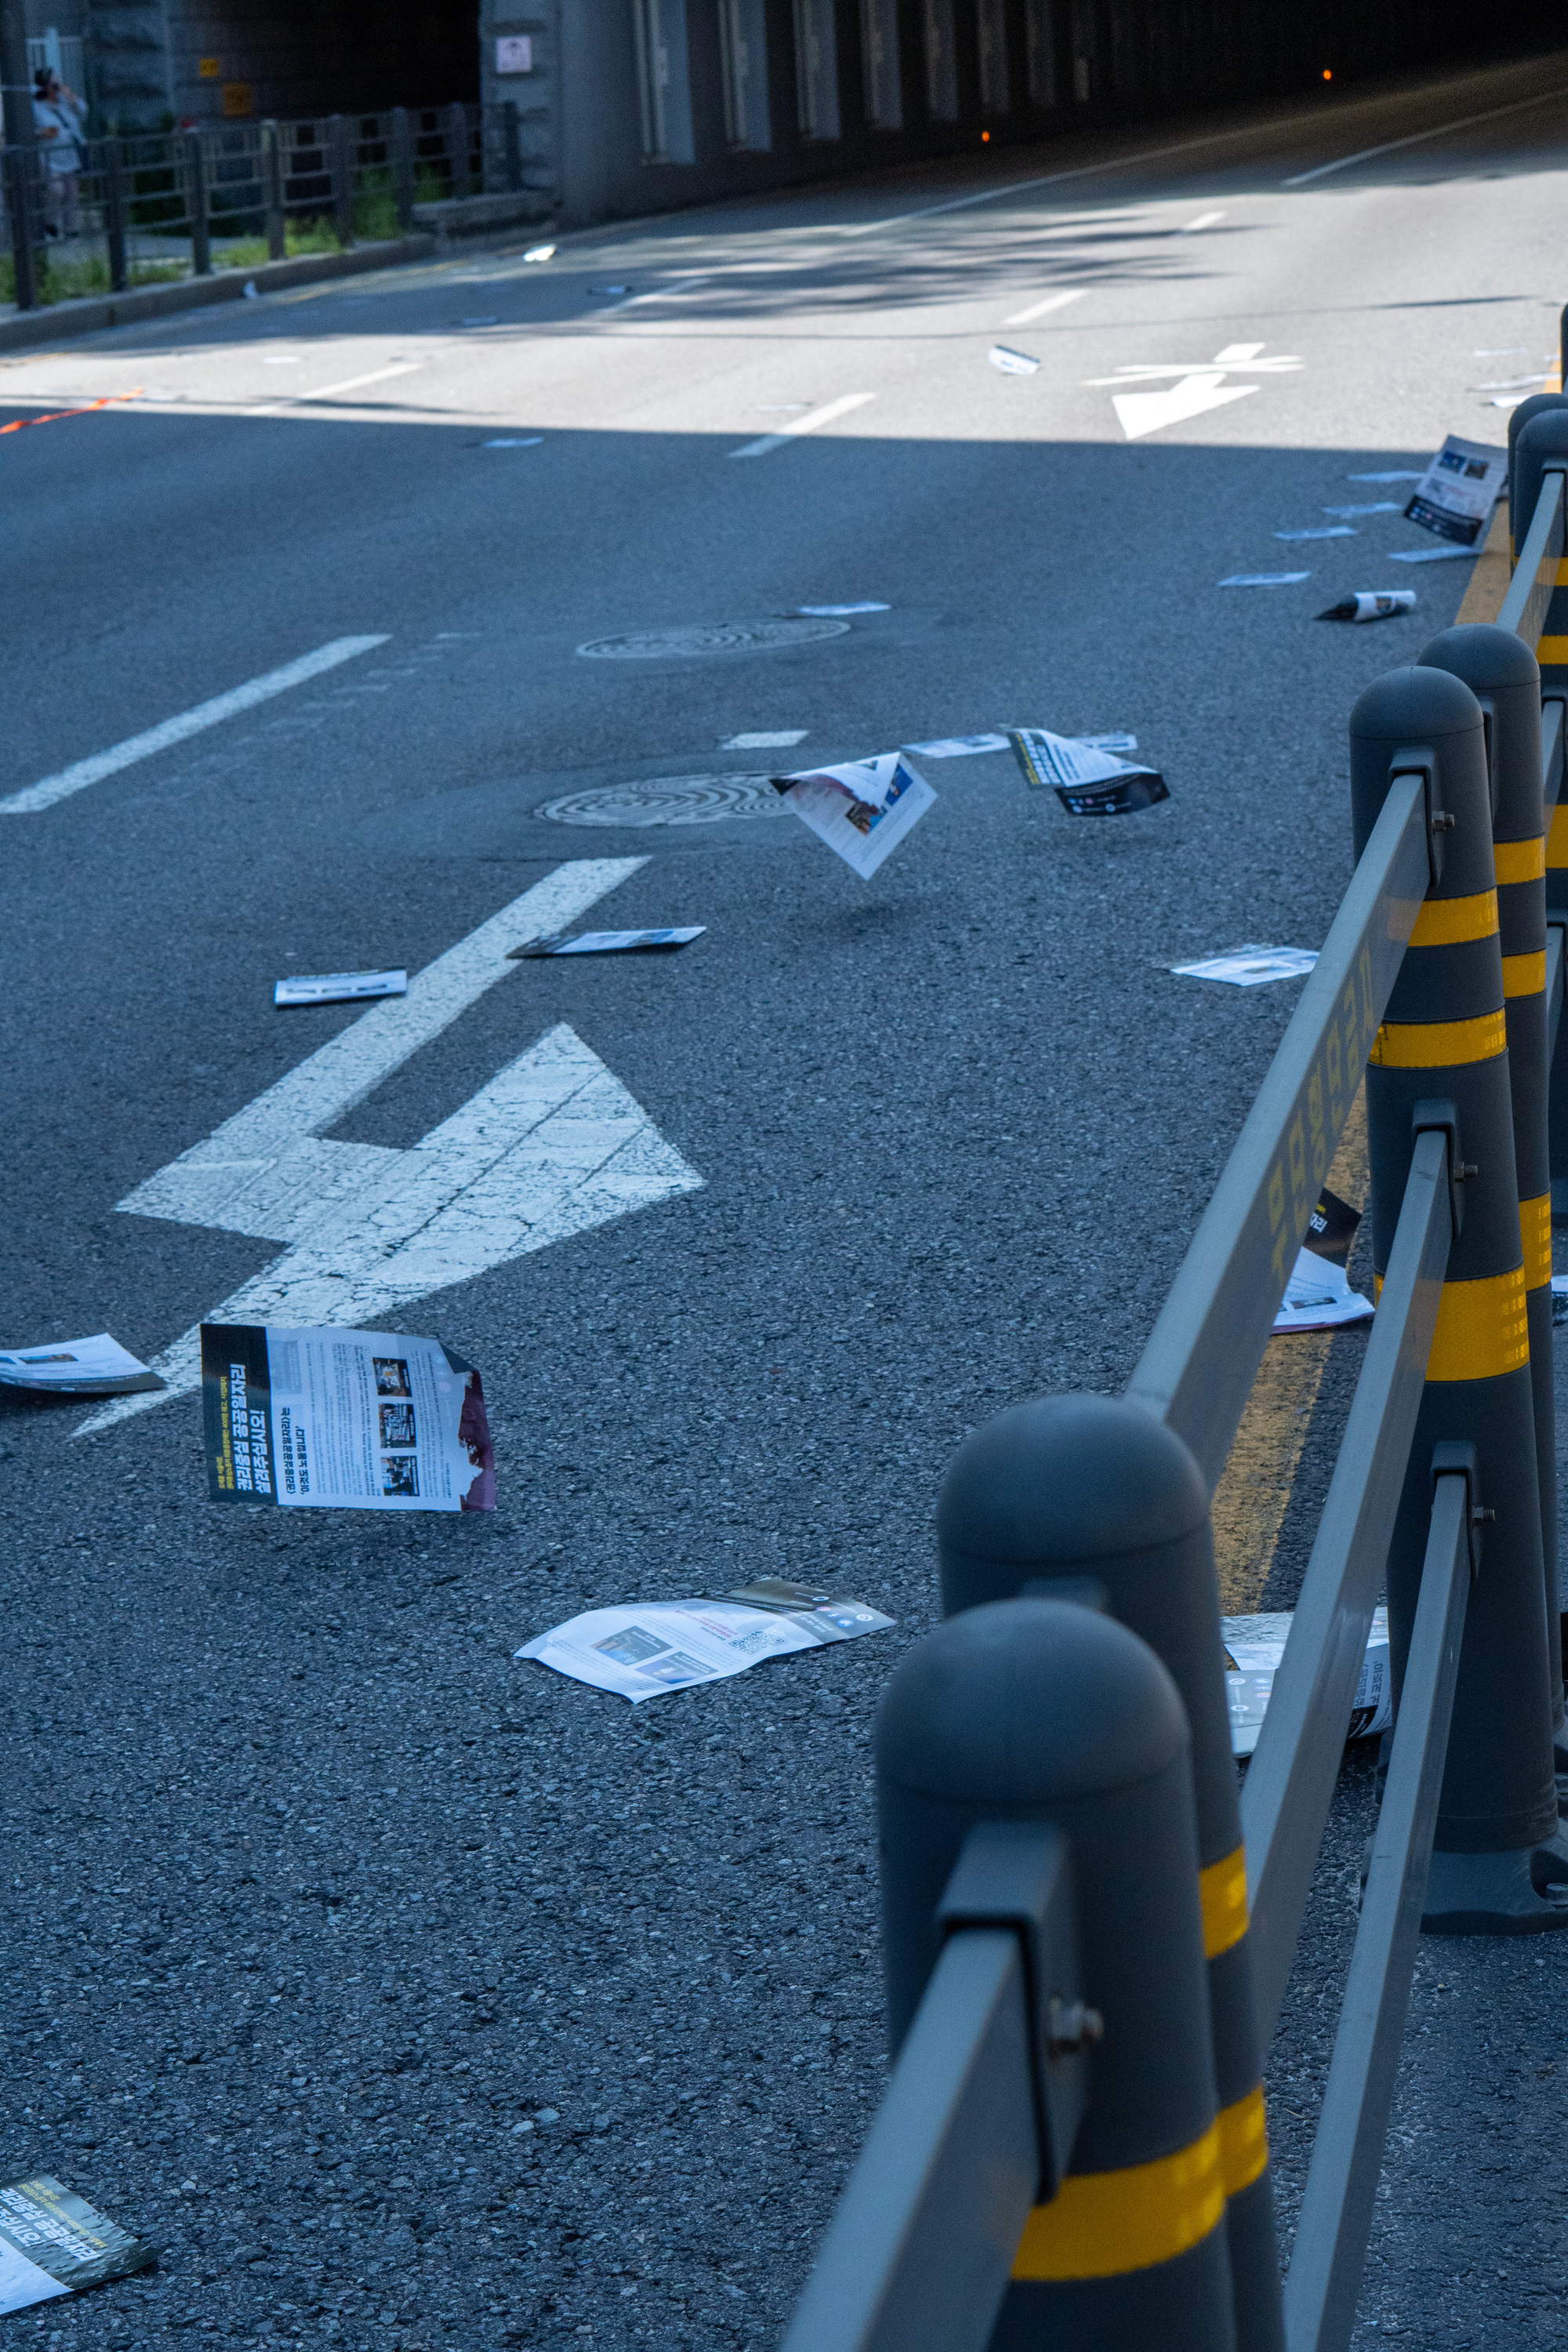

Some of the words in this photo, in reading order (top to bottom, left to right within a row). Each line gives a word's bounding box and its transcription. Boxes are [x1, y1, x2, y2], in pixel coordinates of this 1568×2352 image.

[1268, 943, 1374, 1286] 무단횡단금지
[230, 1363, 249, 1438] 공공일자리
[233, 1441, 252, 1490] 권리중심
[249, 1410, 271, 1494] 살려주십시오!
[0, 2188, 48, 2220] 권리중심
[34, 2219, 101, 2261] 공공일자리
